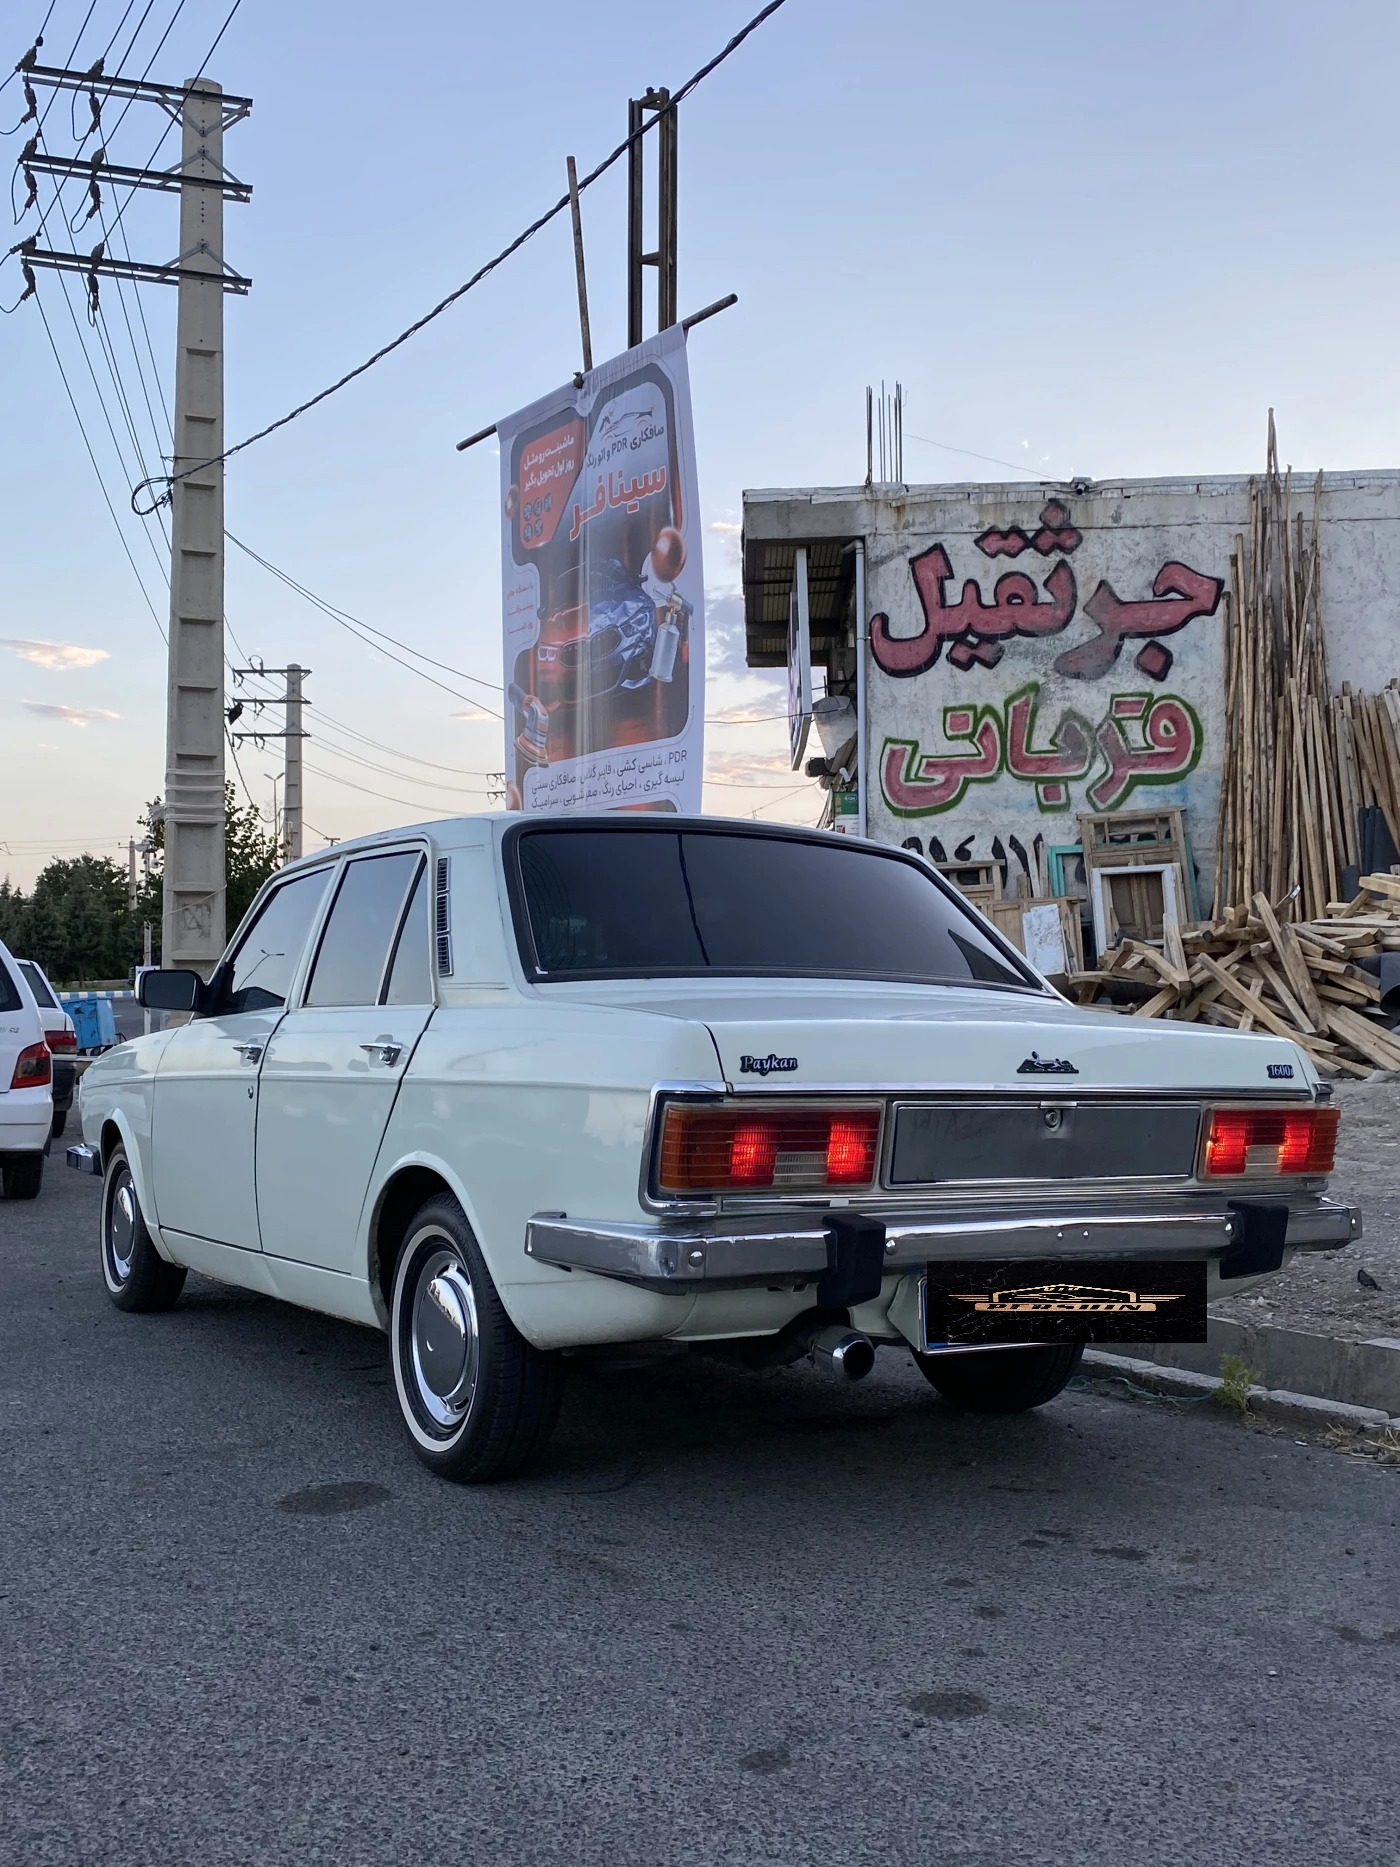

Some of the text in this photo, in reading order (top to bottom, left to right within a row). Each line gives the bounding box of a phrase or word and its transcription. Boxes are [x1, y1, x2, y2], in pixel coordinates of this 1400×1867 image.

[611, 437, 628, 456] PDR
[630, 424, 665, 451] صافکاری
[569, 465, 667, 542] سینافر
[668, 749, 688, 764] PDR
[880, 680, 1205, 818] قربانی
[616, 757, 637, 777] کشی
[638, 753, 663, 774] شاسی
[548, 770, 577, 791] صافکاری
[601, 780, 615, 798] رنگ
[615, 777, 637, 796] احیای
[531, 795, 559, 809] سرامیک
[742, 1055, 798, 1075] Paykan
